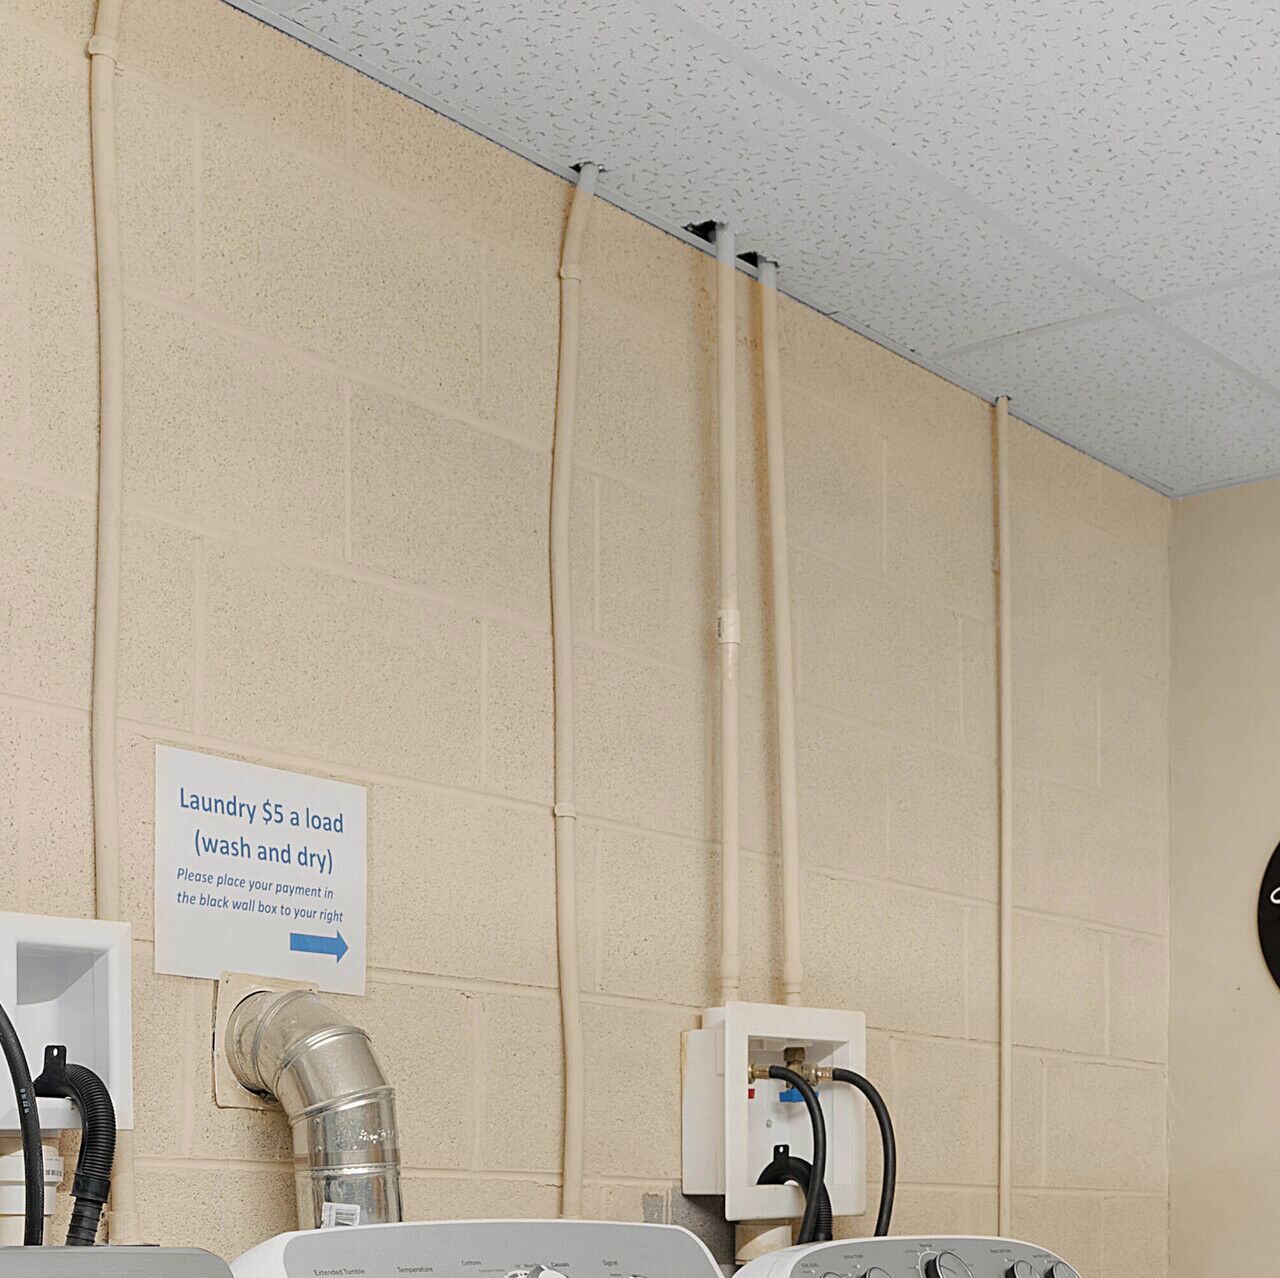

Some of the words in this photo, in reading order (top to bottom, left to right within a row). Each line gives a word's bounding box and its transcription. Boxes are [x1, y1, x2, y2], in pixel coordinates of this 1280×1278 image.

[180, 787, 257, 824] Laundry
[262, 799, 284, 825] $5
[290, 811, 300, 827] a
[306, 807, 344, 834] load
[194, 829, 251, 858] (wash
[257, 844, 291, 864] and
[297, 846, 333, 875] dry)
[176, 867, 214, 884] Please
[216, 873, 246, 888] place
[248, 879, 272, 892] your
[275, 882, 322, 898] payment
[324, 886, 334, 899] in
[176, 891, 196, 905] the
[199, 893, 229, 909] black
[232, 898, 255, 912] wall
[258, 900, 277, 915] box
[280, 904, 291, 917] to
[294, 907, 317, 920] your
[319, 908, 344, 924] right
